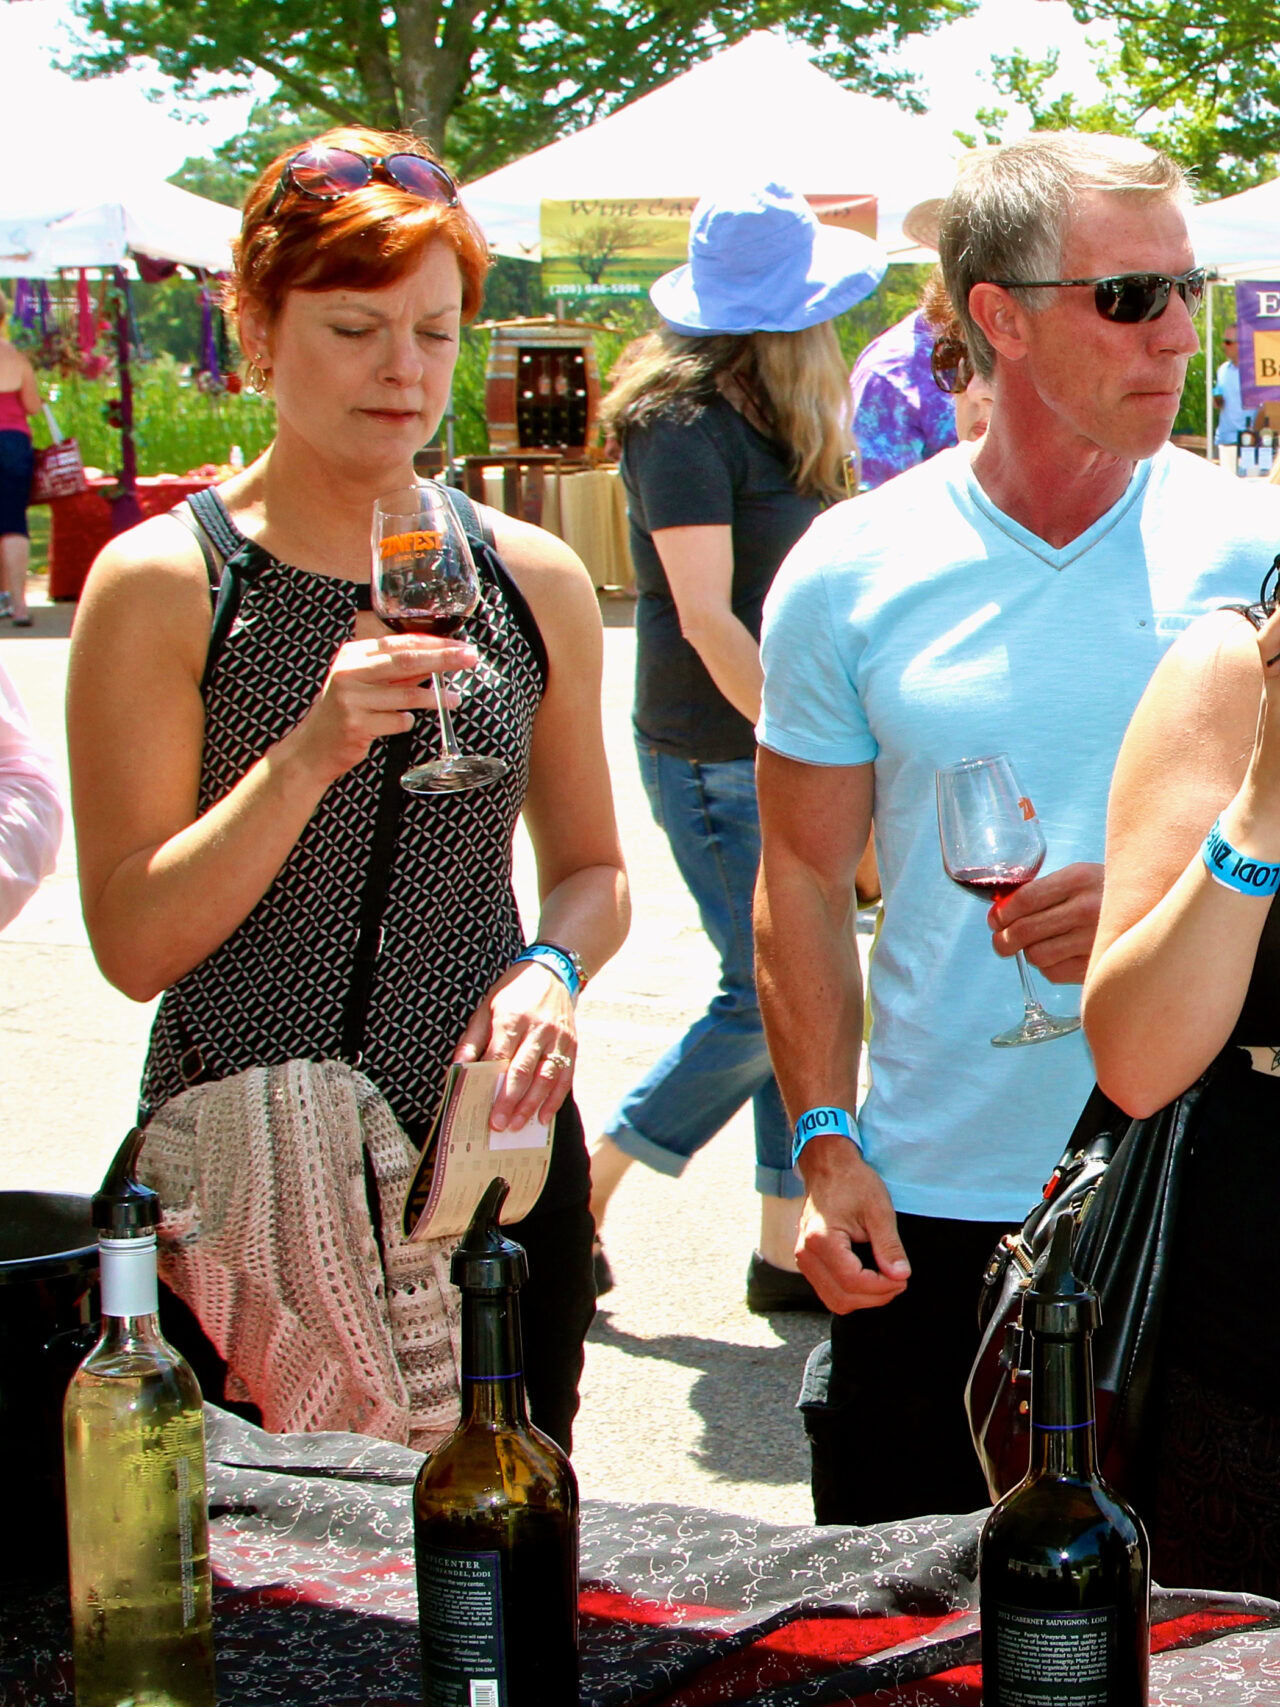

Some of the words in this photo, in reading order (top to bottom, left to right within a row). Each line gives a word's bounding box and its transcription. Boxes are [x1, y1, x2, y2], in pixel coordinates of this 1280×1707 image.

[379, 530, 443, 560] ZINFEST
[1230, 857, 1280, 887] LODI
[802, 1110, 839, 1134] LODI
[472, 1570, 491, 1578] LODI
[1011, 1614, 1044, 1626] CABERNET
[1091, 1615, 1107, 1624] LODI
